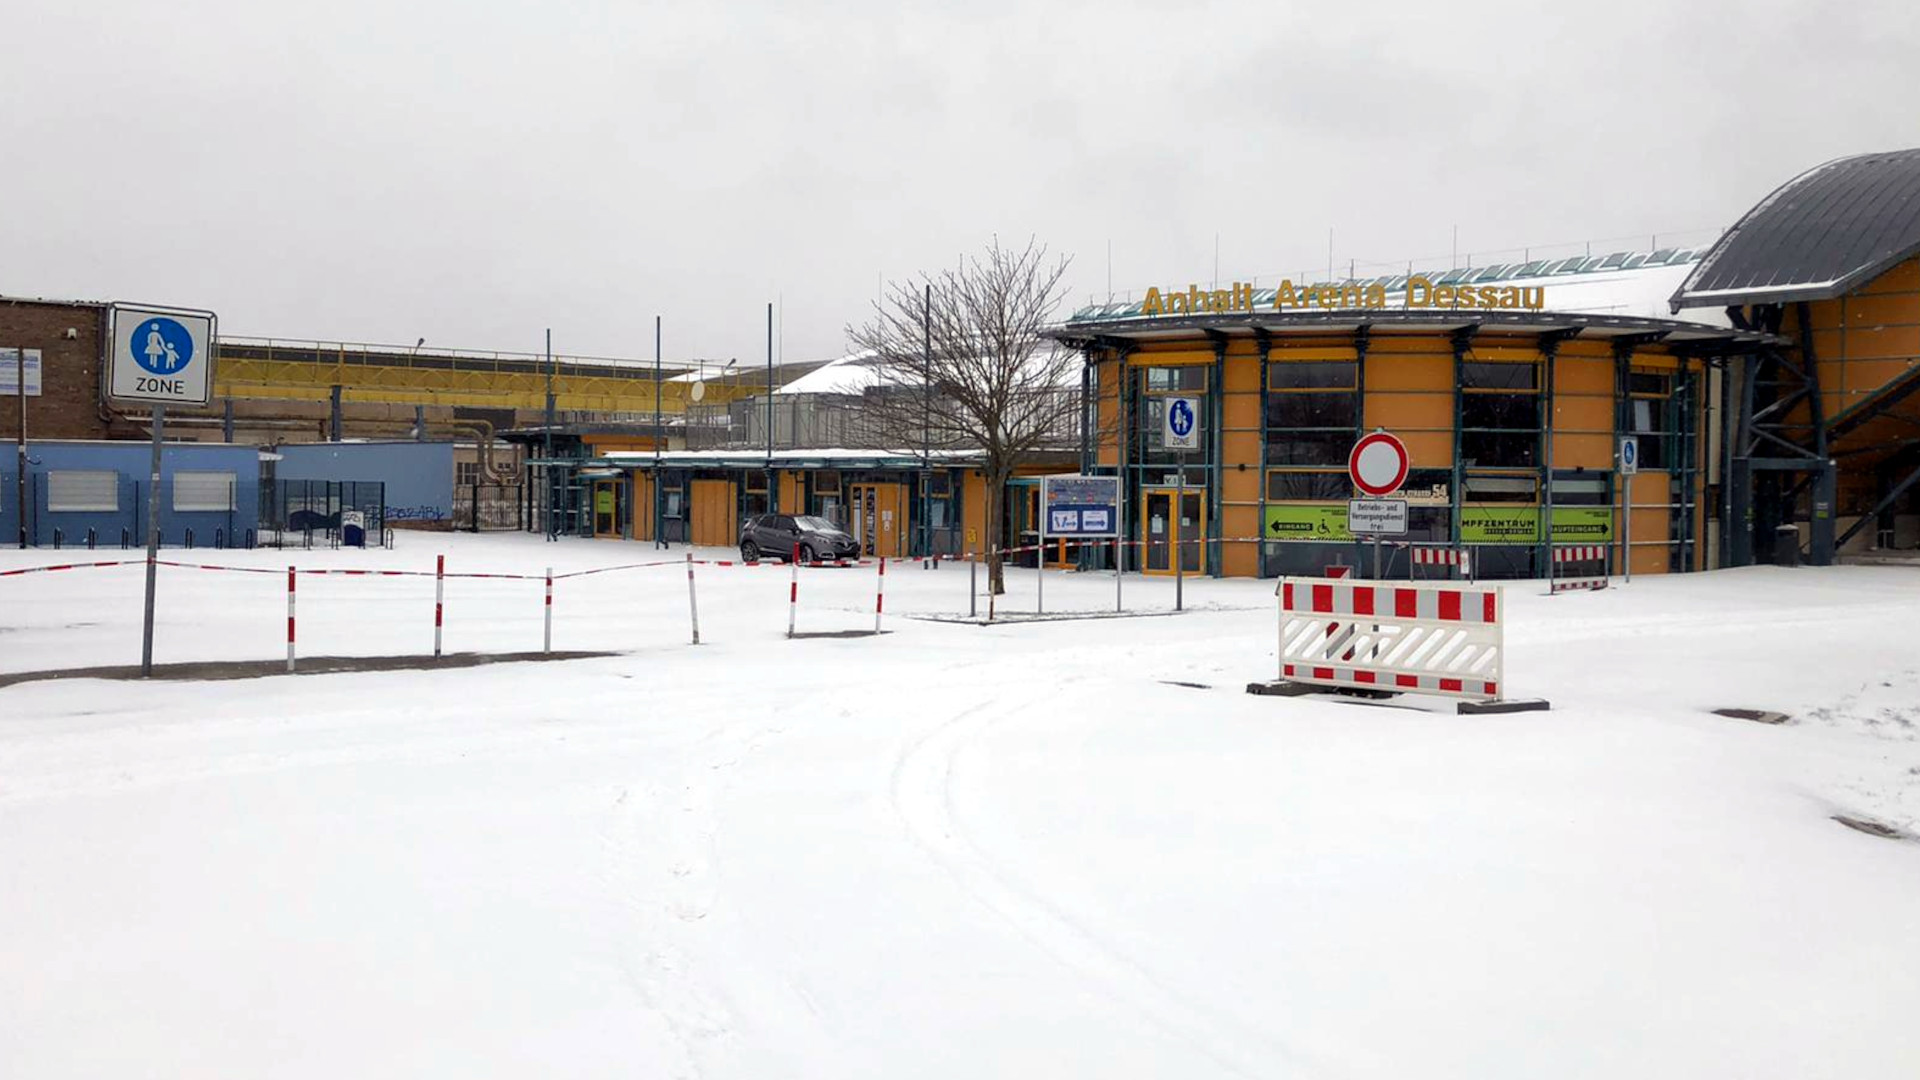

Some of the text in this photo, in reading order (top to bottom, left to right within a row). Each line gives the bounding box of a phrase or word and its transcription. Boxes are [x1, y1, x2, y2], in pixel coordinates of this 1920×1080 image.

[1141, 275, 1545, 314] Anhalt Arena Dessau
[136, 377, 185, 395] ZONE
[1171, 436, 1191, 446] ZONE
[1432, 483, 1448, 497] 54
[1357, 503, 1398, 511] Betriebs- und
[1461, 519, 1535, 528] MPFZENTRUM
[1552, 524, 1603, 533] AUPTEINGANG
